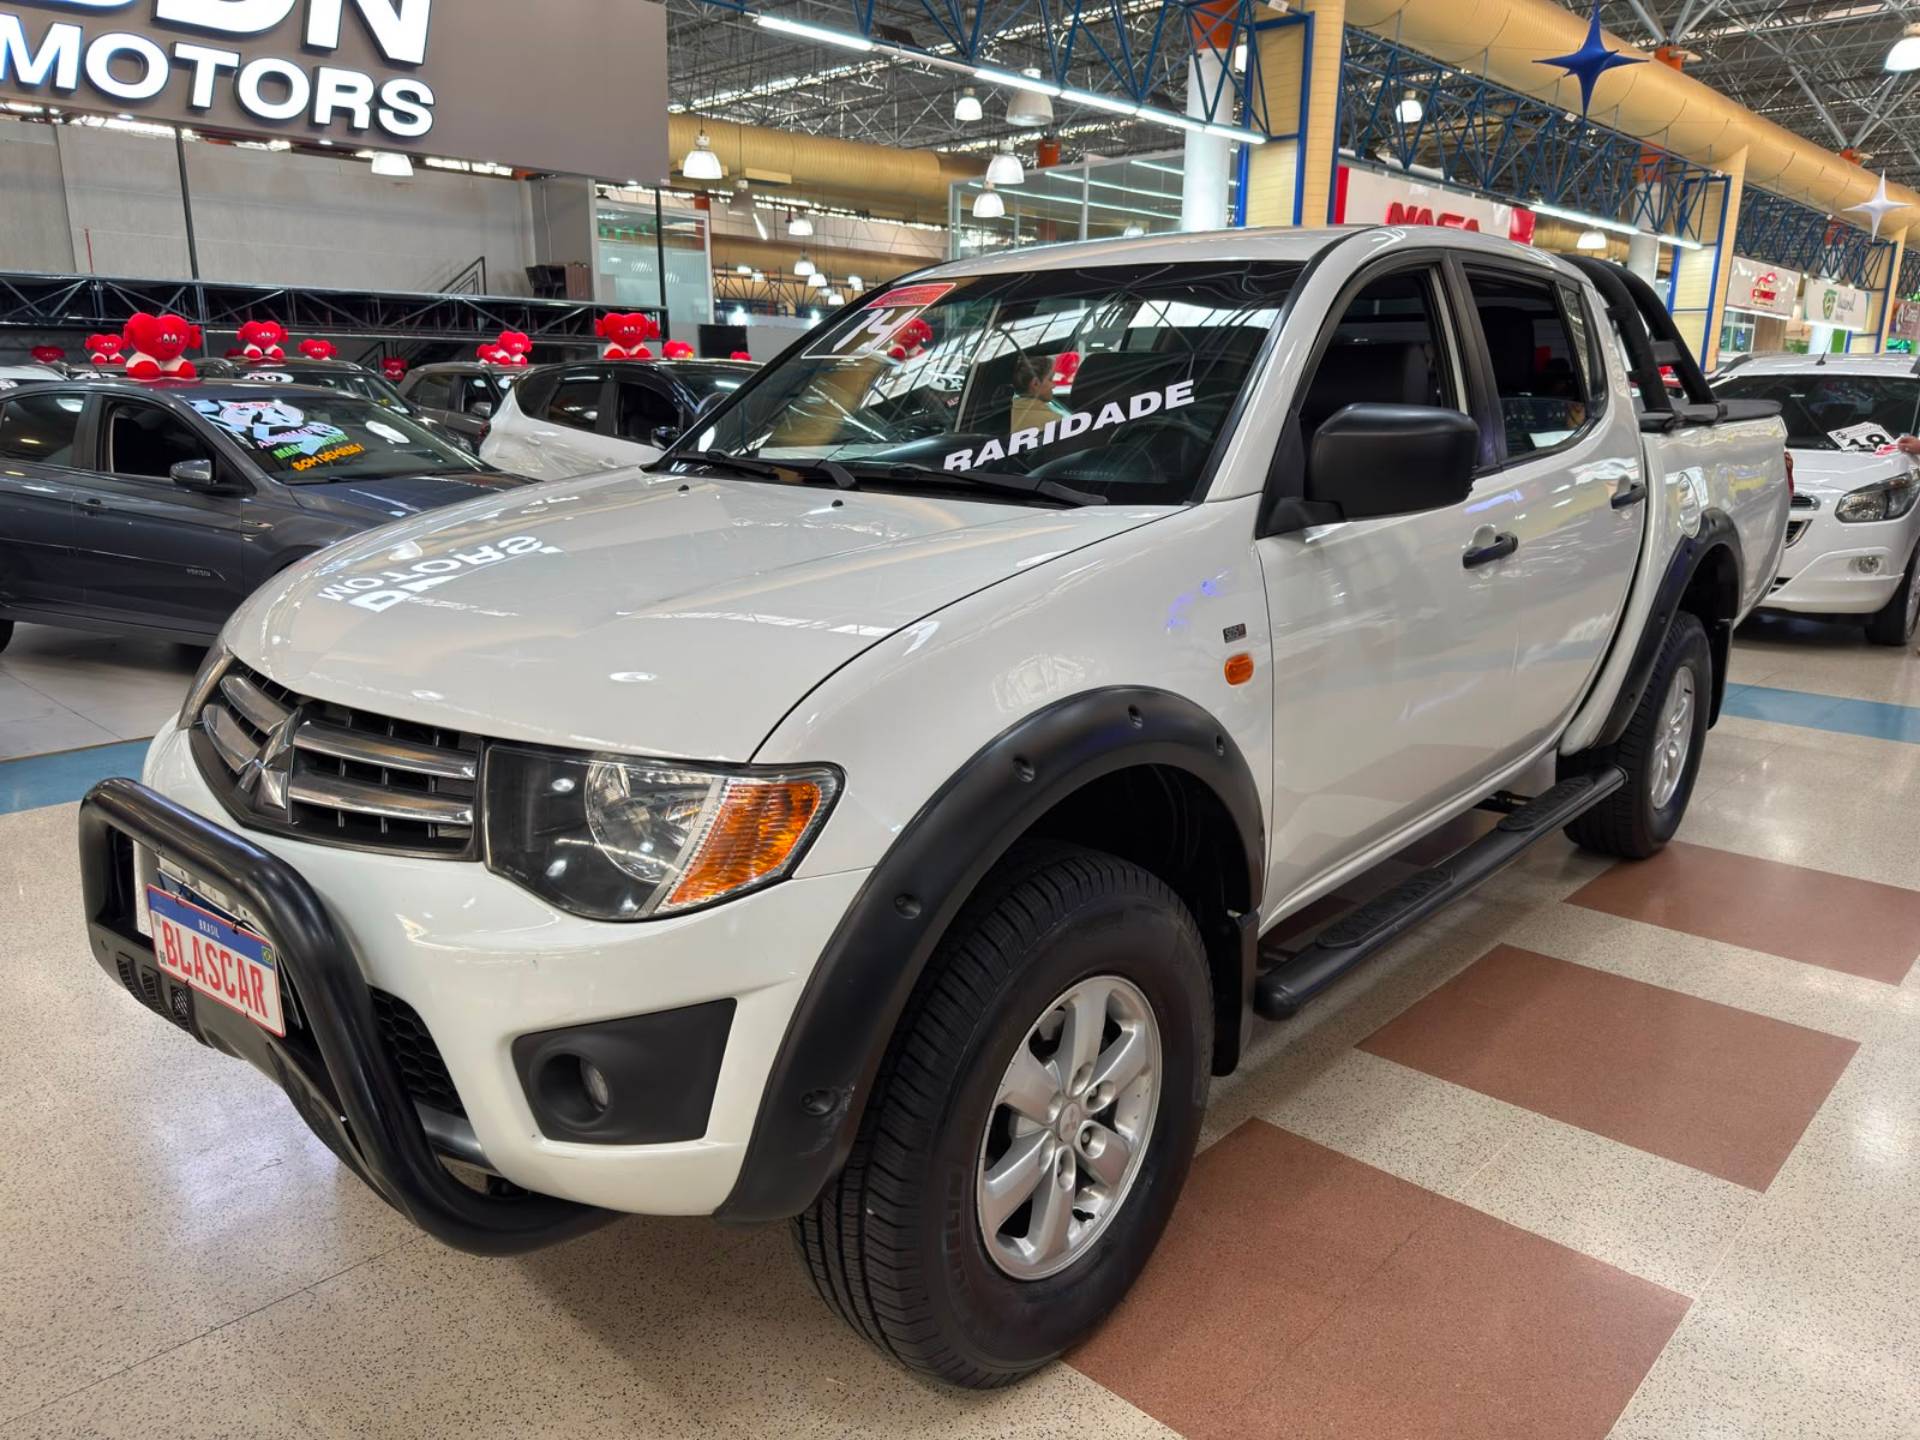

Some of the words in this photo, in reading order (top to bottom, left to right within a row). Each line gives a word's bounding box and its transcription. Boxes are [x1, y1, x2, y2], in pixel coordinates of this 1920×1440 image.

[0, 12, 436, 140] MOTORS
[943, 379, 1195, 473] RARIDADE
[162, 920, 269, 1018] BLASCAR
[199, 919, 220, 938] BRASIL
